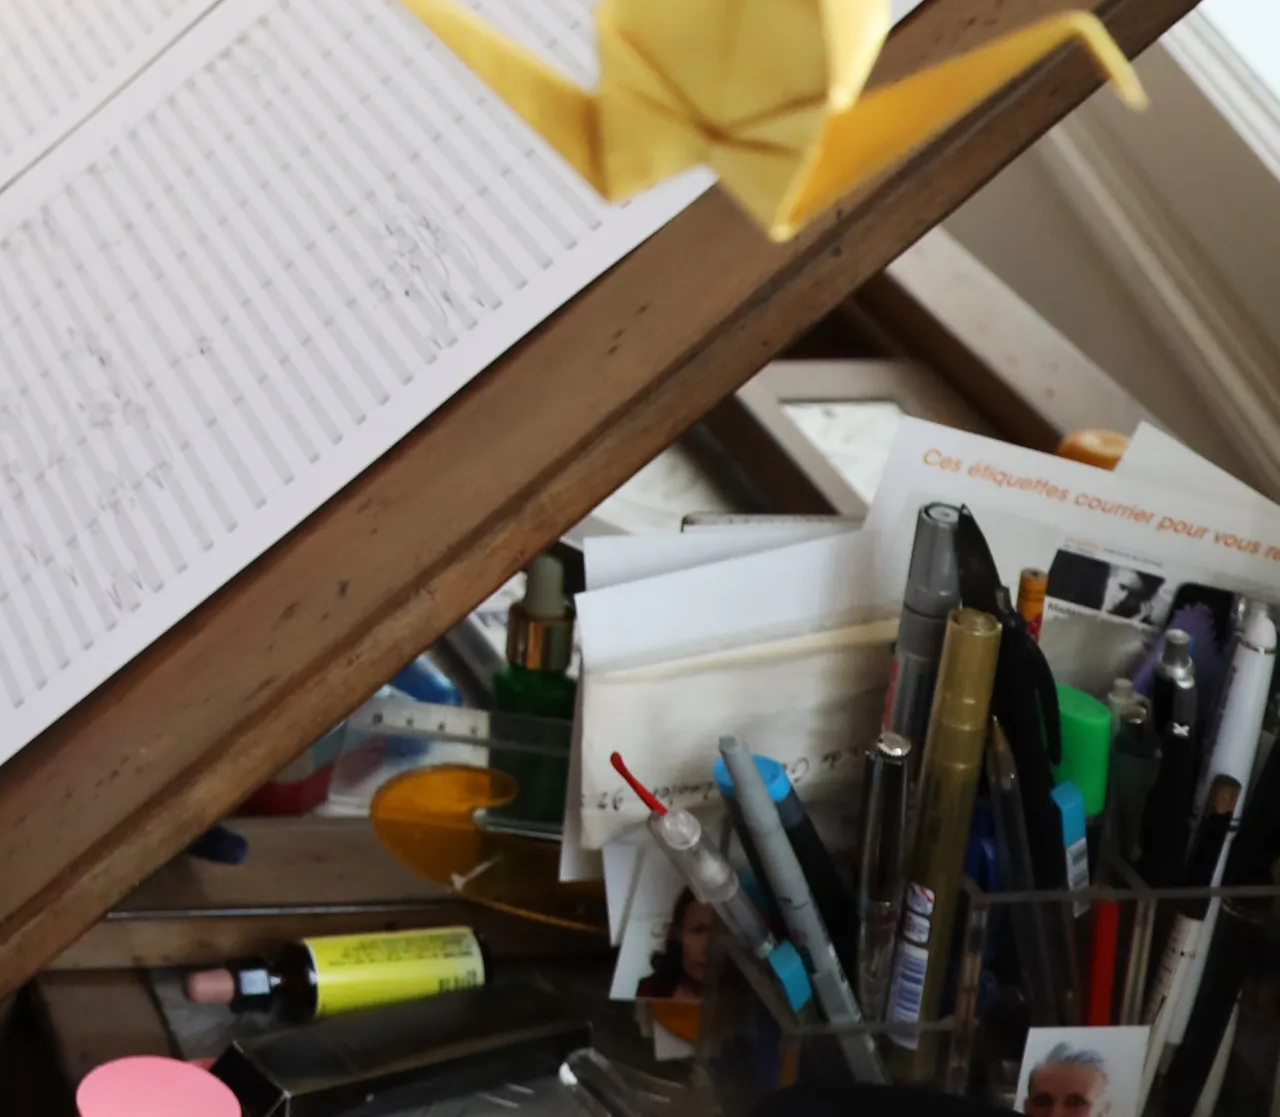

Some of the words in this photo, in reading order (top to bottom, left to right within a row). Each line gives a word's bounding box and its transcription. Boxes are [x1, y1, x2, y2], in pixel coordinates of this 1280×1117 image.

[923, 448, 964, 473] Ces
[966, 461, 1071, 502] étiquettes
[1073, 493, 1157, 526] courrier
[1155, 515, 1209, 541] pour
[1213, 531, 1263, 555] vous
